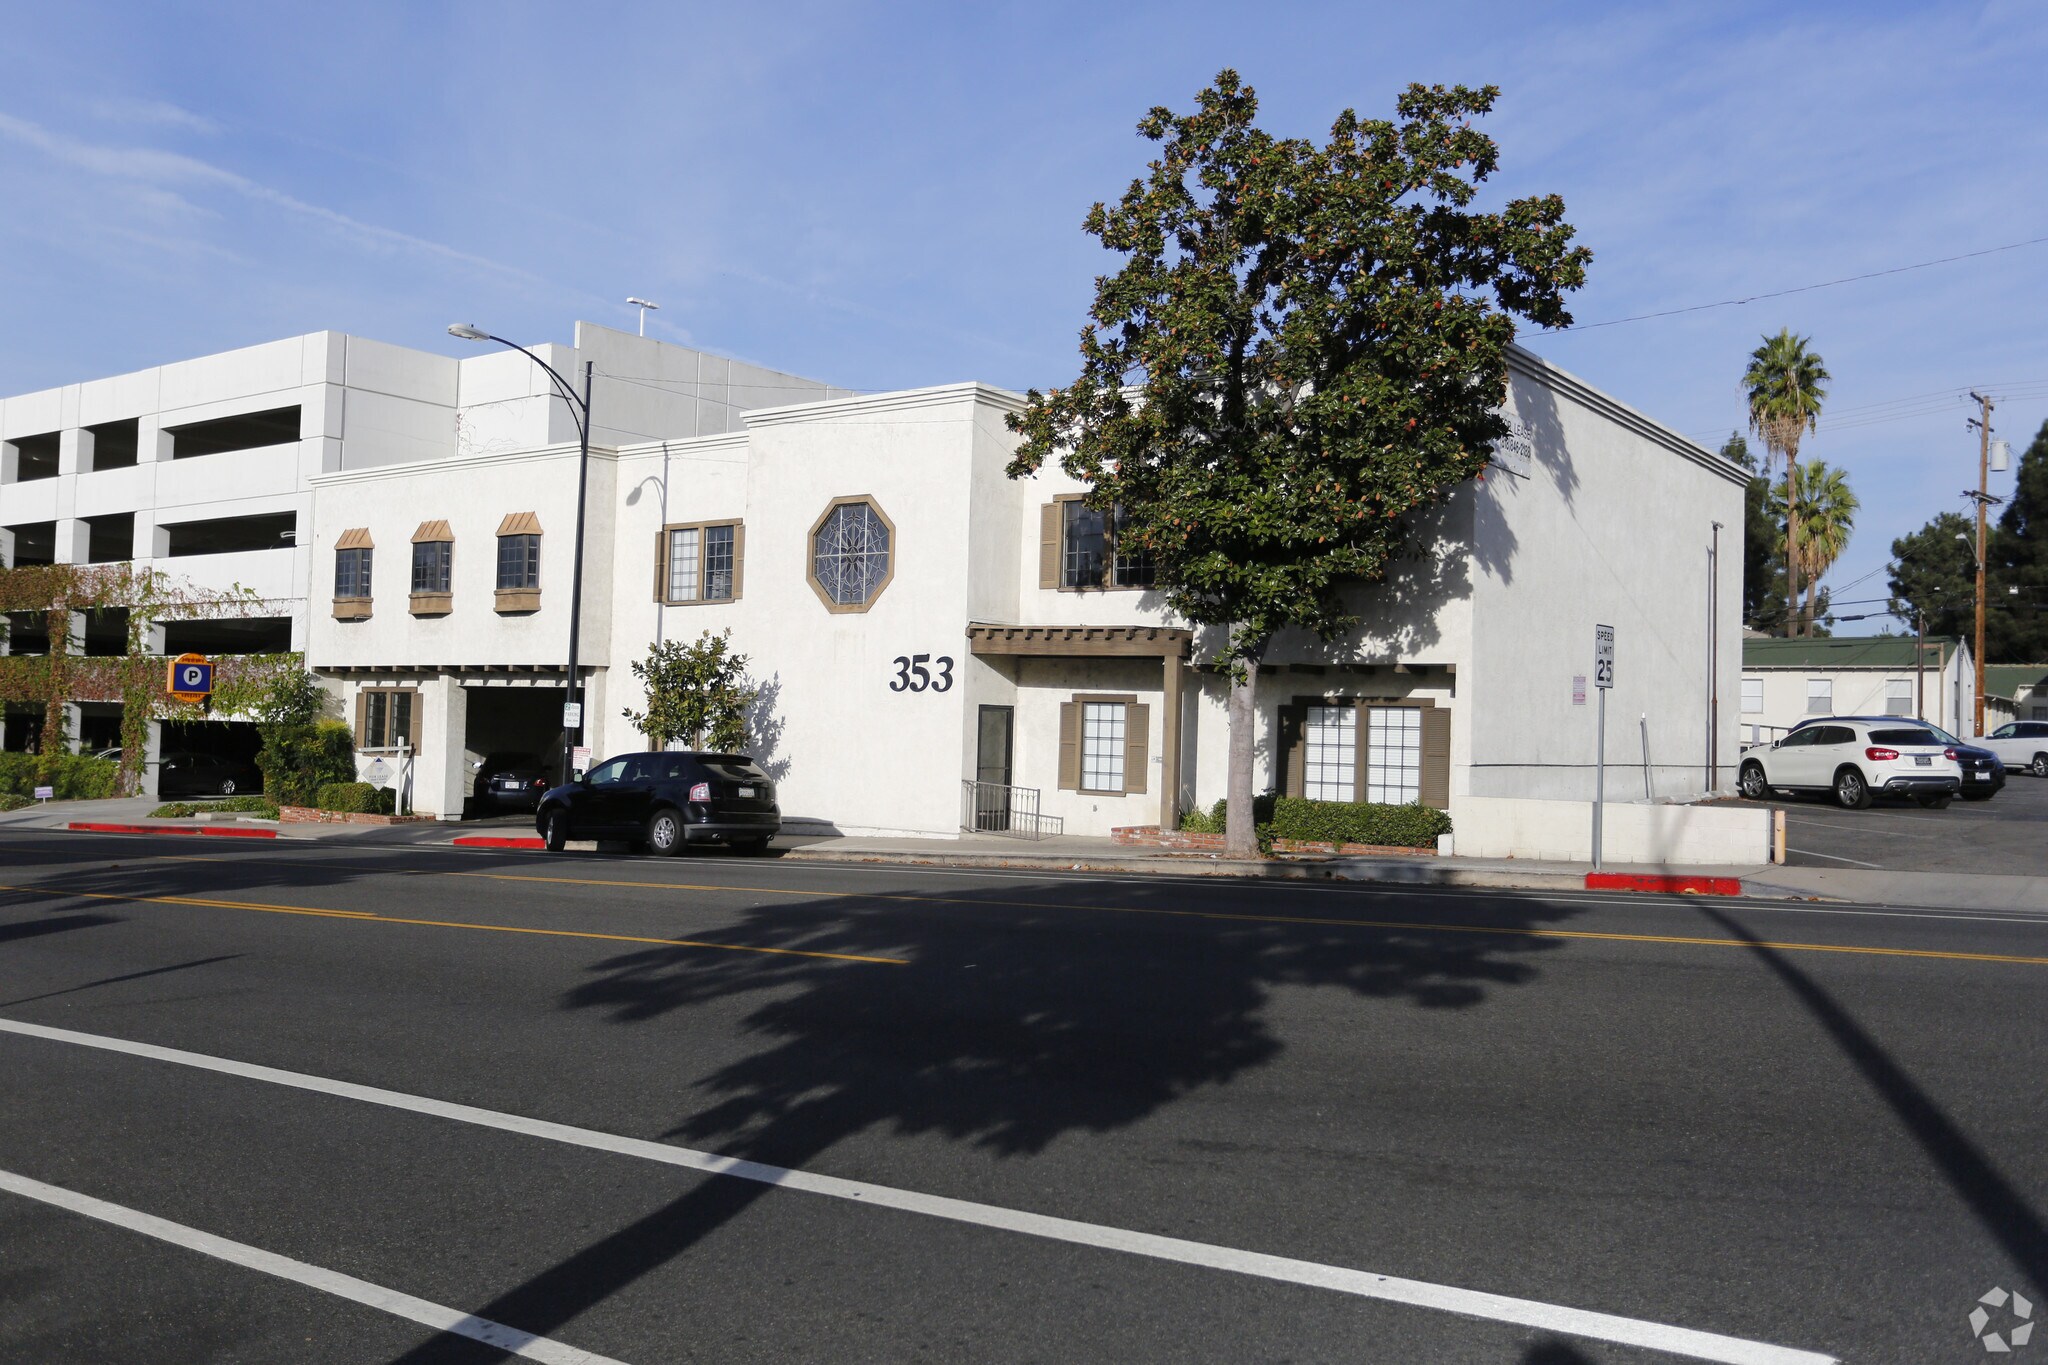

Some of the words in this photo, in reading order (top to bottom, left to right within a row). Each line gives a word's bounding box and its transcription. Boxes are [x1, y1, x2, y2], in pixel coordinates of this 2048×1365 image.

[1514, 423, 1531, 441] LEASE
[1597, 630, 1613, 642] SPEED
[1598, 645, 1612, 655] LIMIT
[188, 670, 199, 682] P
[889, 653, 954, 693] 353
[1597, 659, 1612, 682] 25
